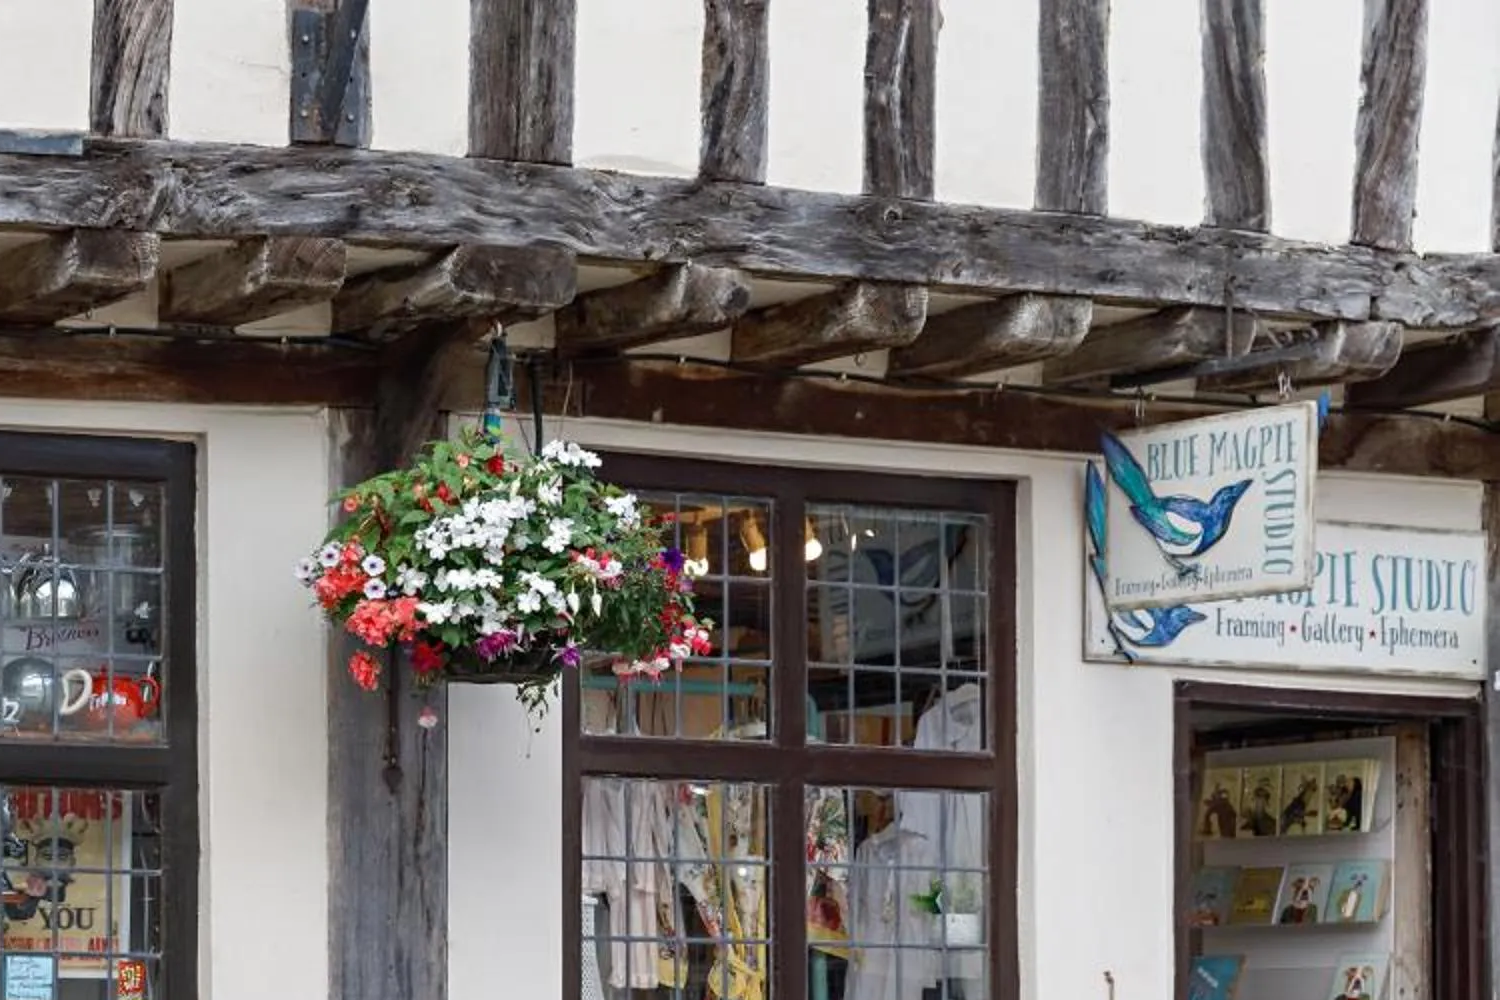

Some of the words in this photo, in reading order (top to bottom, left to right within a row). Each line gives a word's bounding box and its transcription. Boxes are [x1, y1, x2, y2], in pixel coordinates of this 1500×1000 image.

[1146, 433, 1200, 482] BLUE
[1209, 420, 1298, 476] MAGPIE
[1261, 467, 1297, 575] STUDIO
[1371, 553, 1478, 615] STUDIO
[1215, 607, 1286, 647] Framing
[1300, 611, 1364, 652] Gallery
[1380, 615, 1460, 656] Ephemera
[38, 907, 98, 930] YOU
